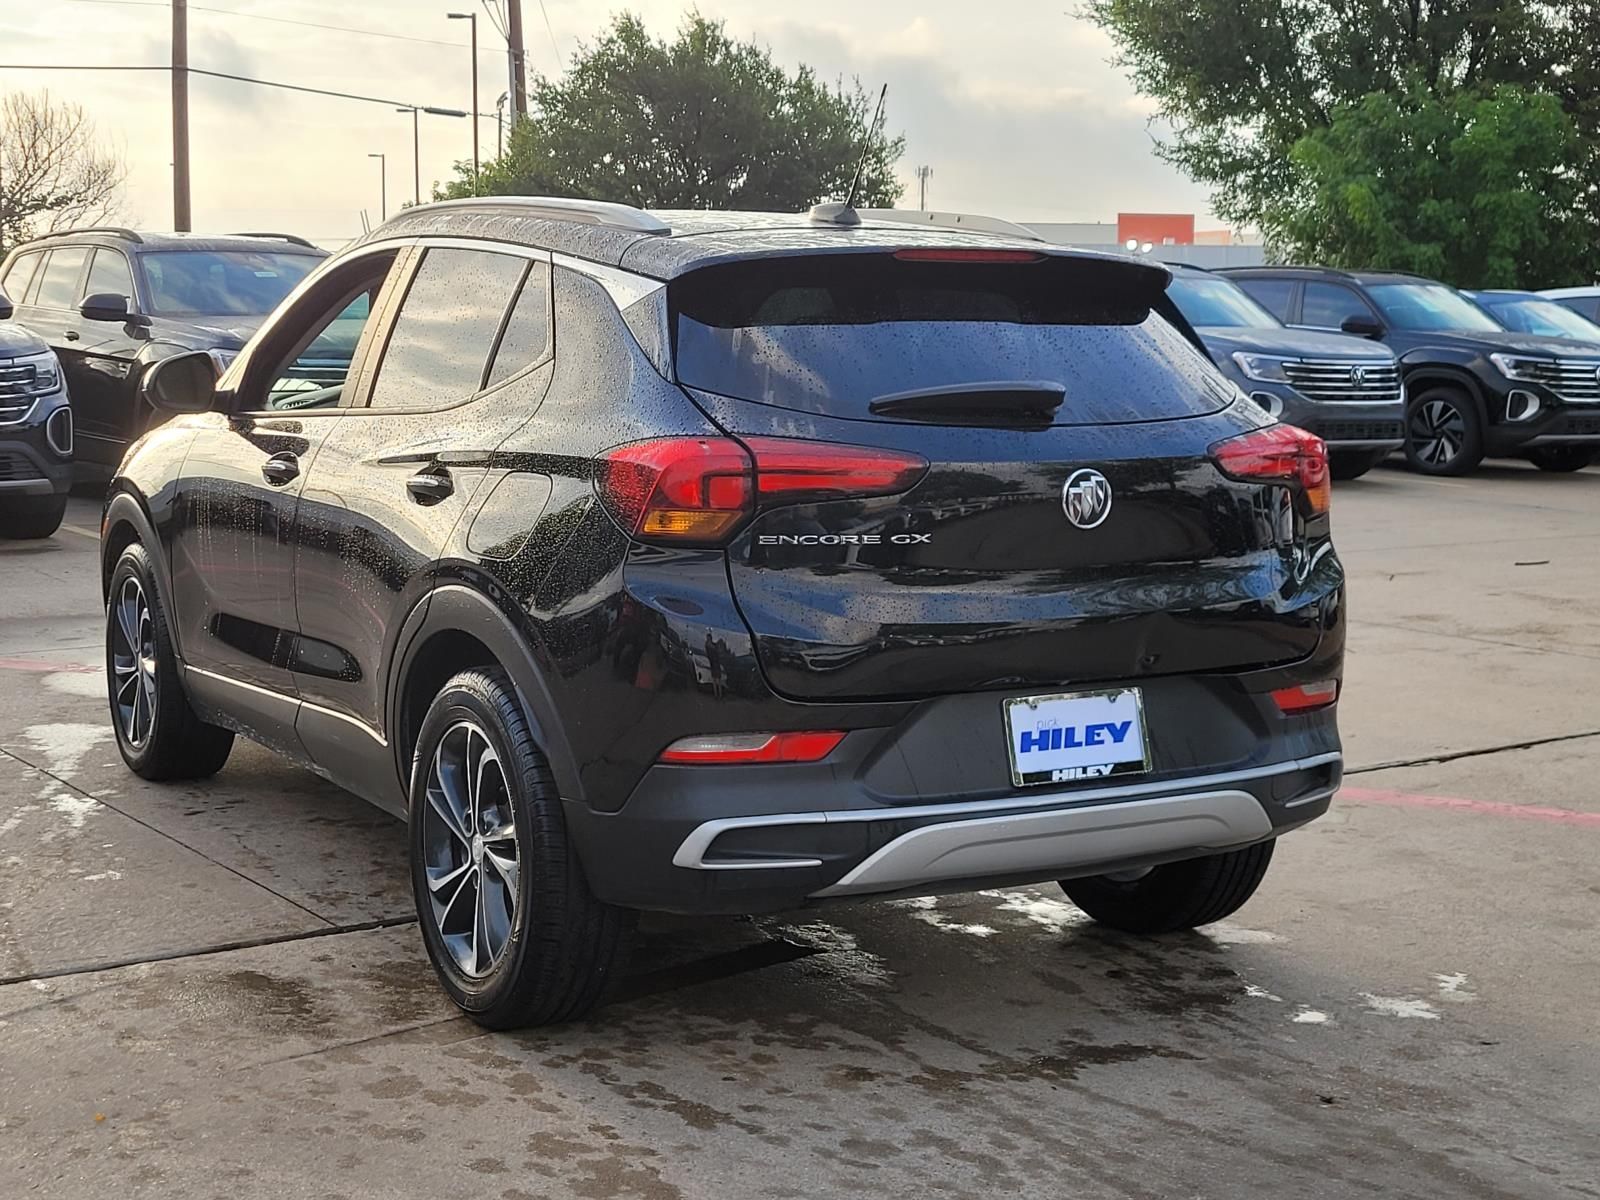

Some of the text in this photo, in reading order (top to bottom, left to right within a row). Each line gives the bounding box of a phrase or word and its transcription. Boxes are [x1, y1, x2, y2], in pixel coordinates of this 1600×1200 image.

[758, 533, 932, 545] ENCORE GX
[1020, 720, 1132, 753] HILEY
[1052, 763, 1115, 781] HILEY
